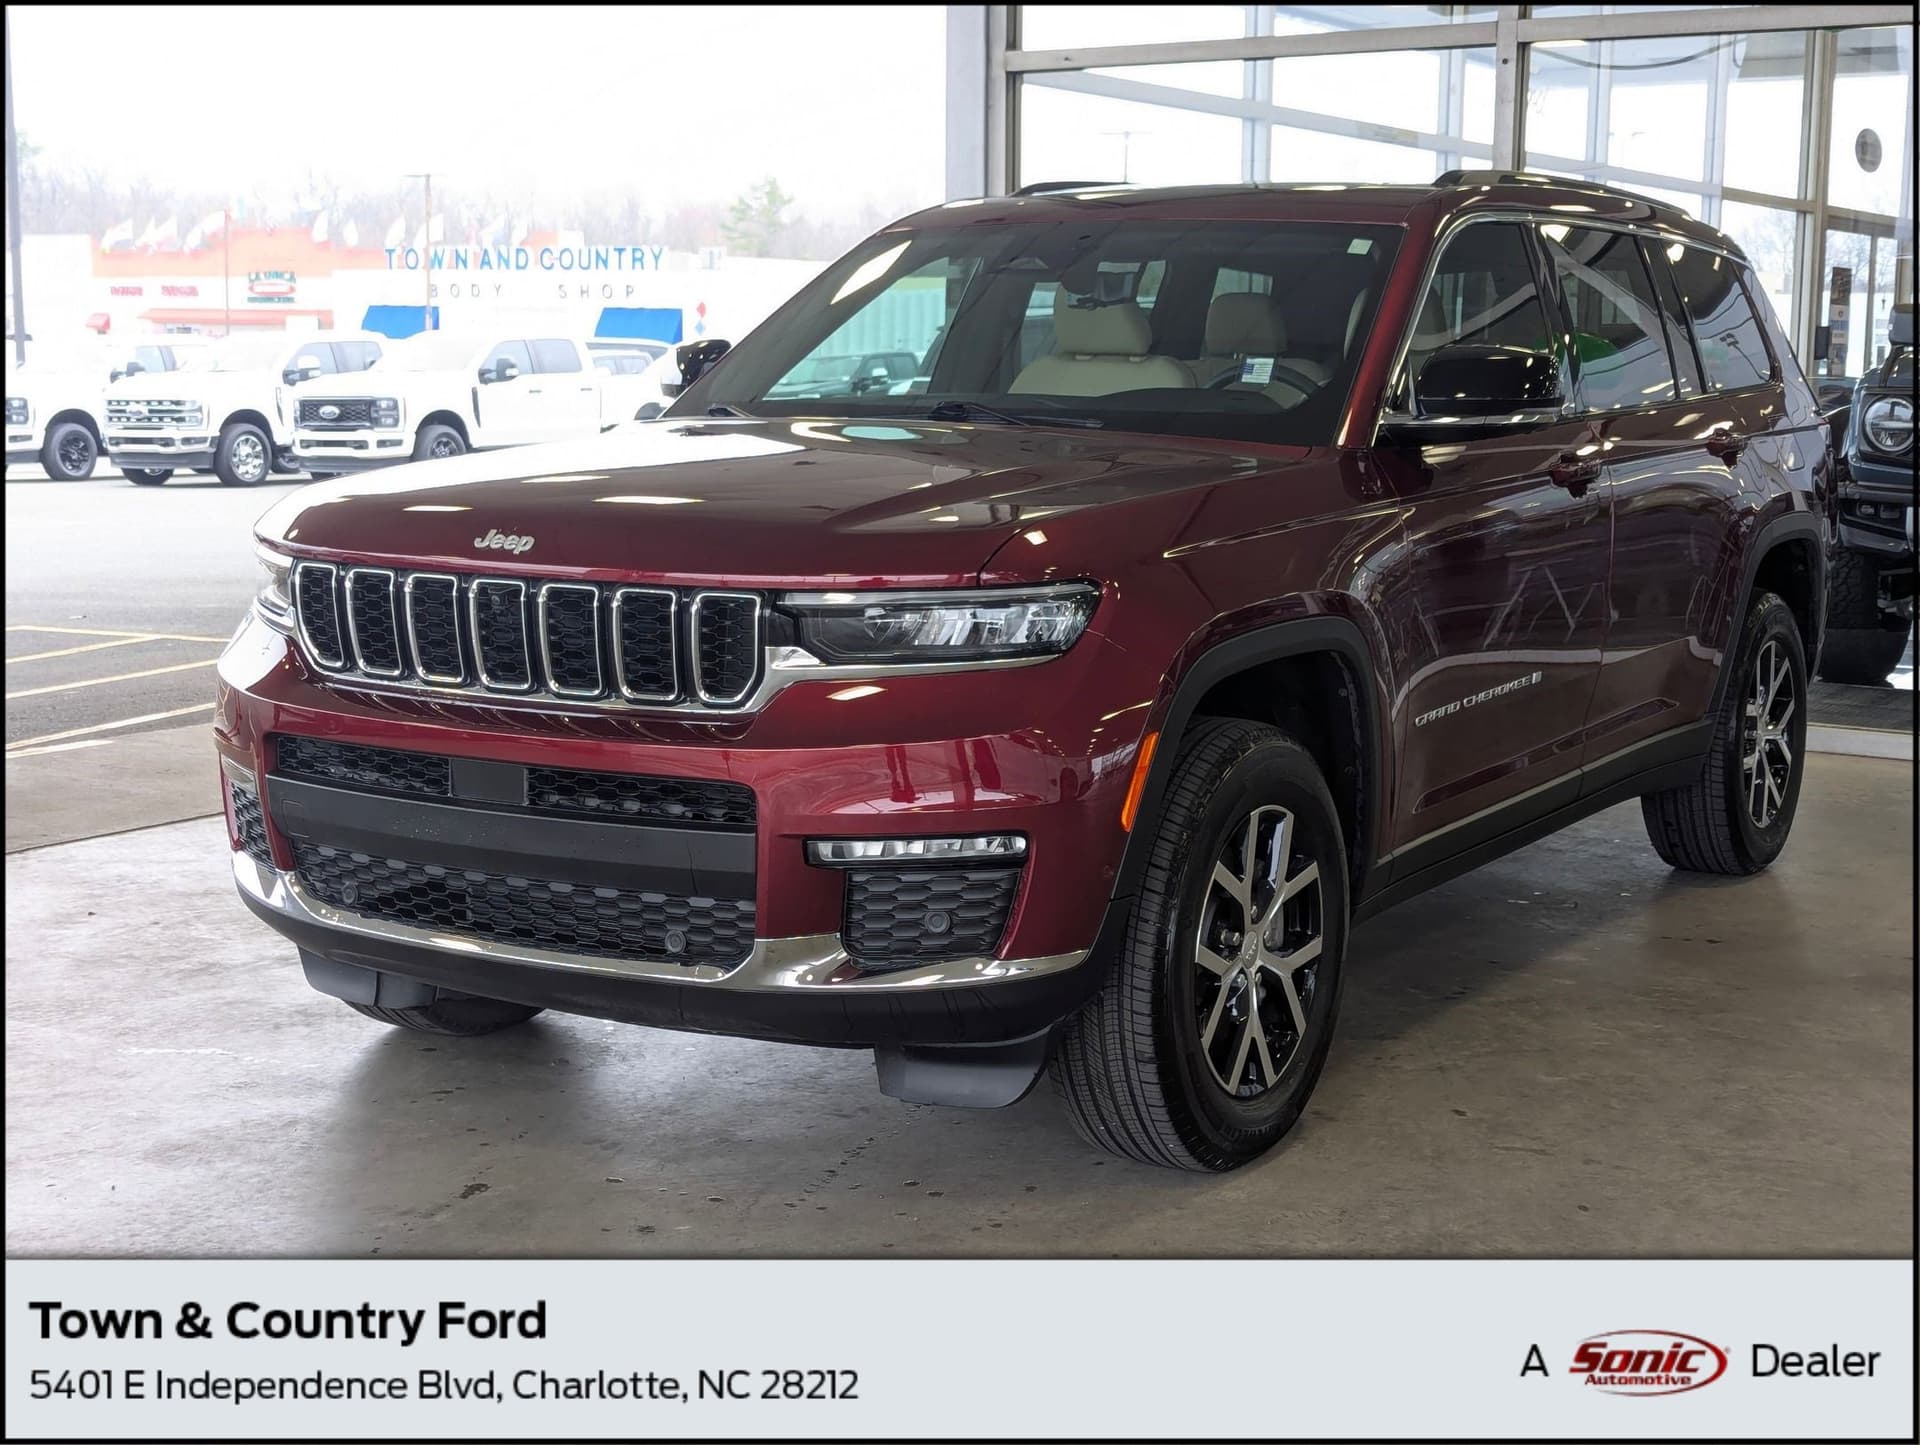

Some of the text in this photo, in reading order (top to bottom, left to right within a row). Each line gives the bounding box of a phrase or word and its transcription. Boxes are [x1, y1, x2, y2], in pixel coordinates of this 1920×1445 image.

[385, 248, 664, 270] TOWN AND COUNTRY
[430, 284, 635, 299] BODY SHOP
[474, 529, 535, 555] Jeep
[1415, 702, 1461, 727] GRAND
[1463, 676, 1531, 707] CHEROKEE
